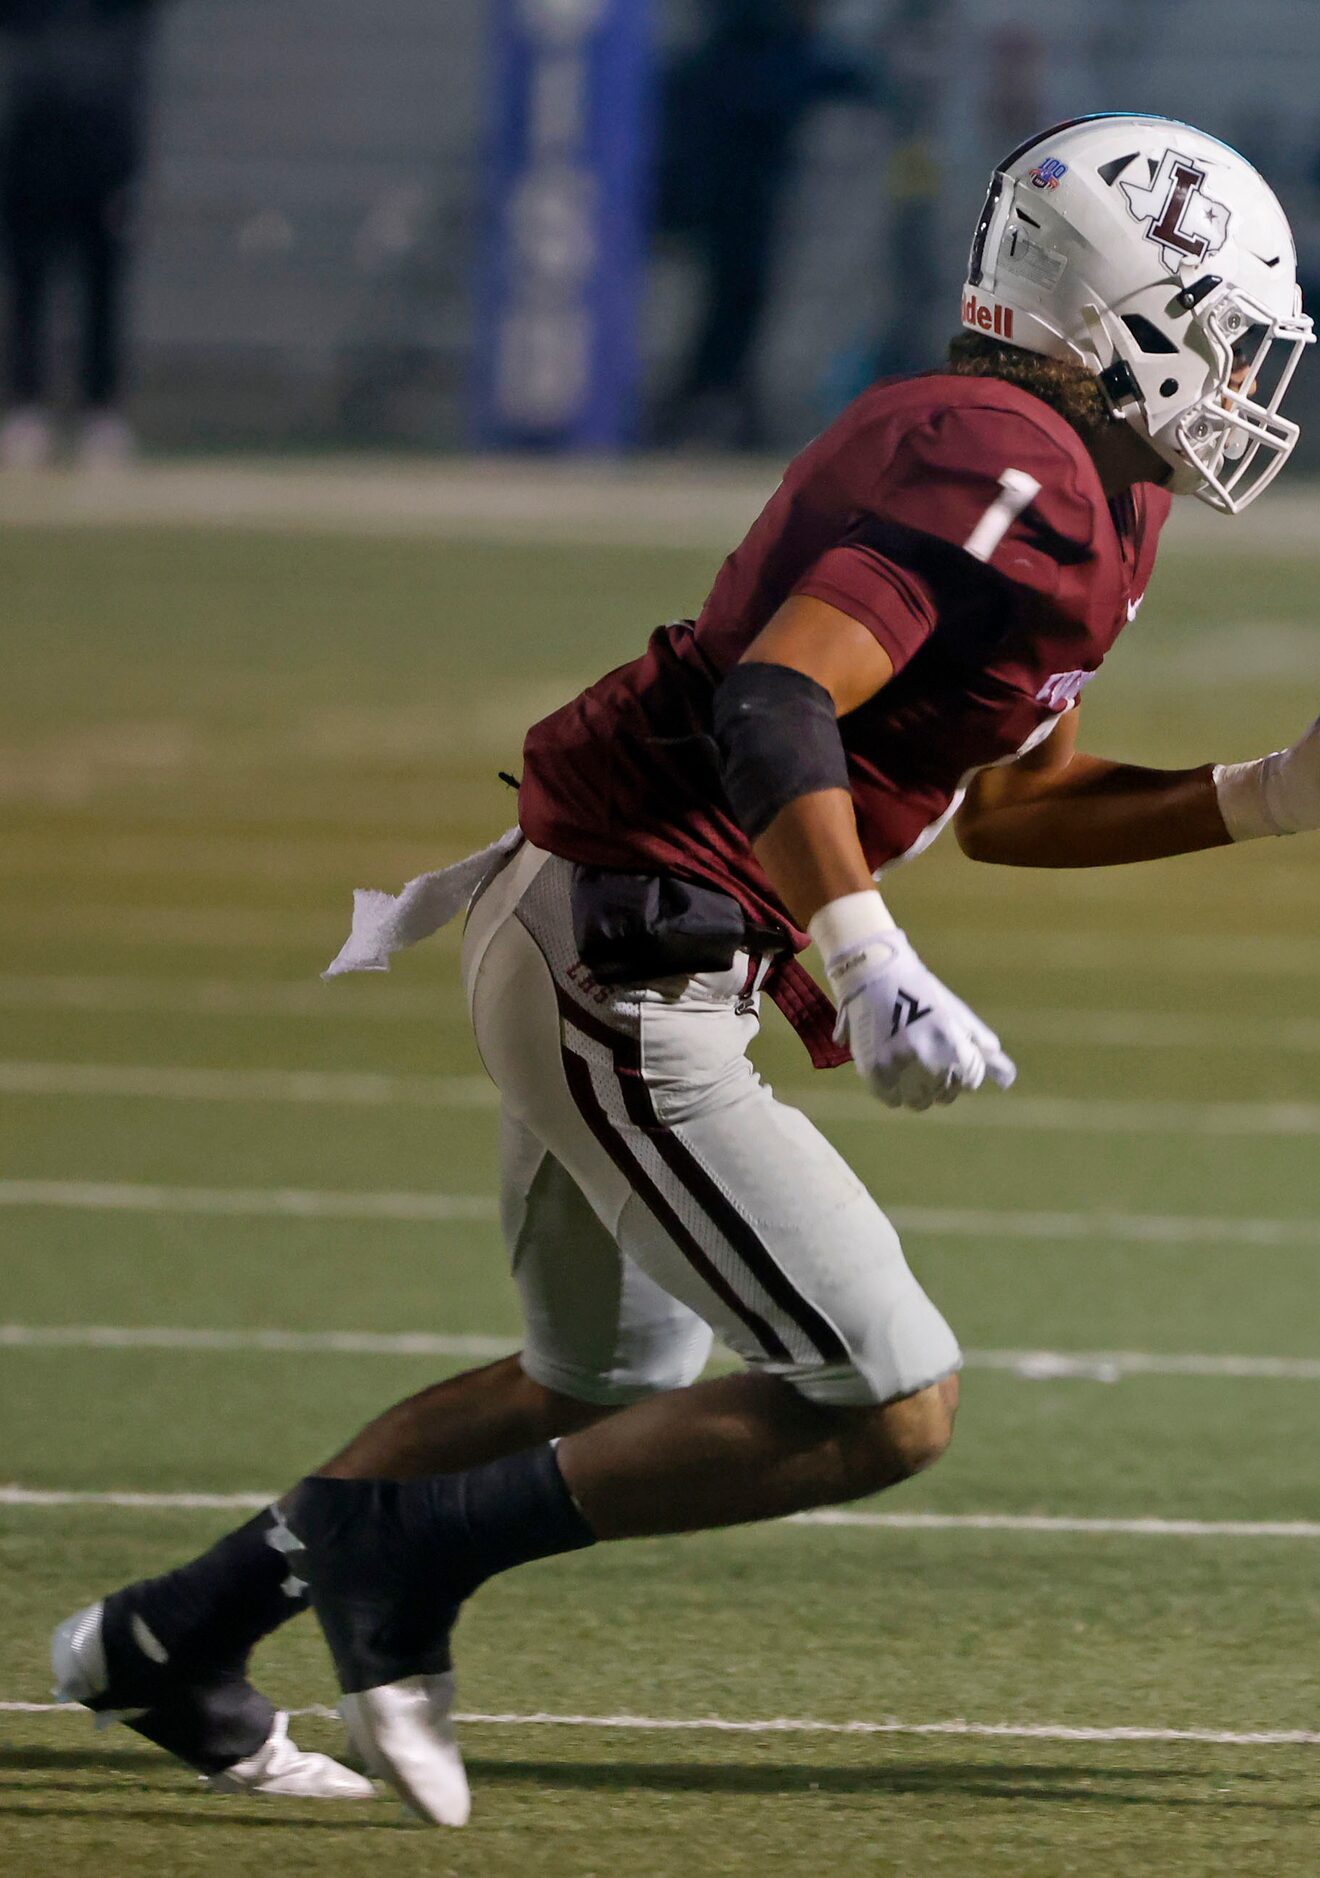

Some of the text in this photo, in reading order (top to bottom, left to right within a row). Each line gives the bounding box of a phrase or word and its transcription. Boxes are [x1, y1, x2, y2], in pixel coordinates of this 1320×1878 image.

[1010, 229, 1019, 256] 1
[962, 294, 1014, 340] dell
[962, 467, 1042, 562] 1
